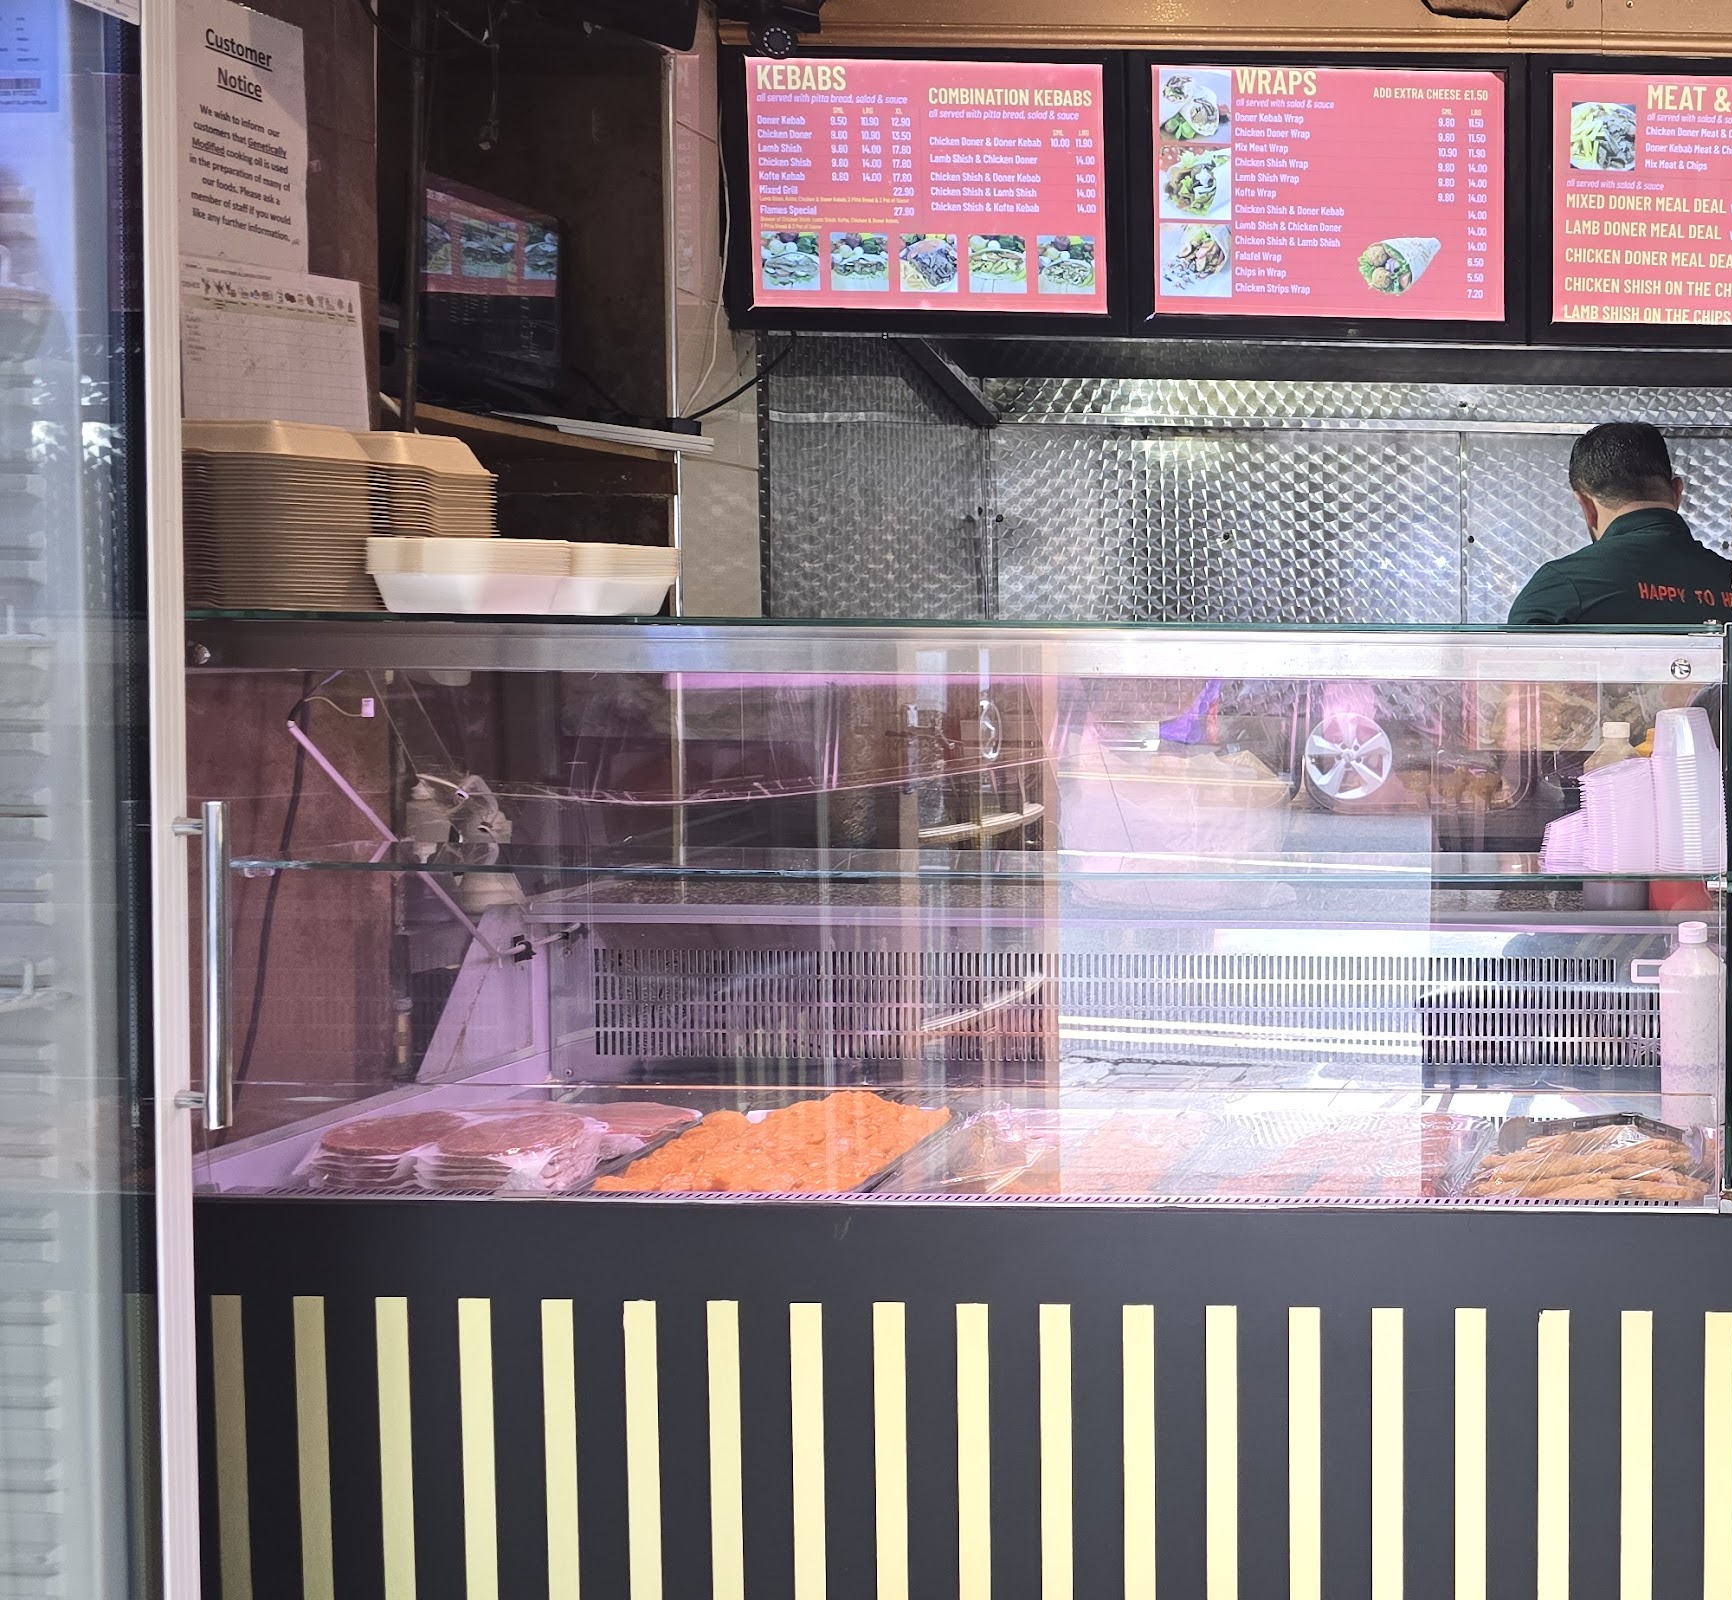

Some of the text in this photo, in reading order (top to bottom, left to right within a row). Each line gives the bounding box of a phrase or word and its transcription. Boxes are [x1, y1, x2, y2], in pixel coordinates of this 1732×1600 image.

[205, 28, 272, 67] Customer
[217, 67, 262, 97] Notice
[756, 64, 846, 90] KEBABS
[1236, 69, 1317, 95] WRAPS
[928, 87, 1091, 106] COMBINATION KEBABS
[1373, 87, 1488, 100] ADD EXTRA CHEESE £1.50
[1647, 84, 1706, 110] MEAT
[1714, 87, 1730, 112] &
[200, 104, 280, 138] We wish to inform our
[193, 122, 287, 158] customers that Genetically
[929, 136, 959, 145] Chicken
[961, 136, 984, 146] Doner
[985, 137, 992, 146] &
[993, 137, 1016, 146] Doner
[1018, 138, 1041, 147] Kebab
[192, 138, 288, 174] Modified cooking oil is used
[190, 154, 290, 191] in the preparation of many of
[202, 177, 214, 187] our
[217, 180, 238, 193] foods.
[240, 186, 261, 200] Please
[263, 195, 274, 204] ask
[191, 192, 291, 225] member of staff if you would
[1566, 193, 1726, 213] MIXED DONER MEAL DEAL
[193, 208, 290, 241] like any further information.
[1565, 219, 1721, 239] LAMB DONER MEAL DEAL
[1262, 252, 1281, 263] Wrap
[1565, 247, 1620, 264] CHICKEN
[1624, 250, 1667, 265] DONER
[1671, 252, 1705, 267] MEAL
[1235, 266, 1256, 277] Chips
[1258, 267, 1265, 276] in
[1266, 267, 1286, 278] Wrap
[1235, 282, 1265, 292] Chicken
[1266, 283, 1289, 294] Strips
[1290, 284, 1310, 295] Wrap
[1565, 277, 1619, 293] CHICKEN
[1624, 279, 1660, 294] SHISH
[1665, 280, 1682, 295] ON
[1686, 281, 1711, 296] THE
[1564, 305, 1731, 325] LAMB SHISH ON THE CHIPS
[1638, 582, 1684, 602] HAPPY
[1694, 589, 1714, 605] TO
